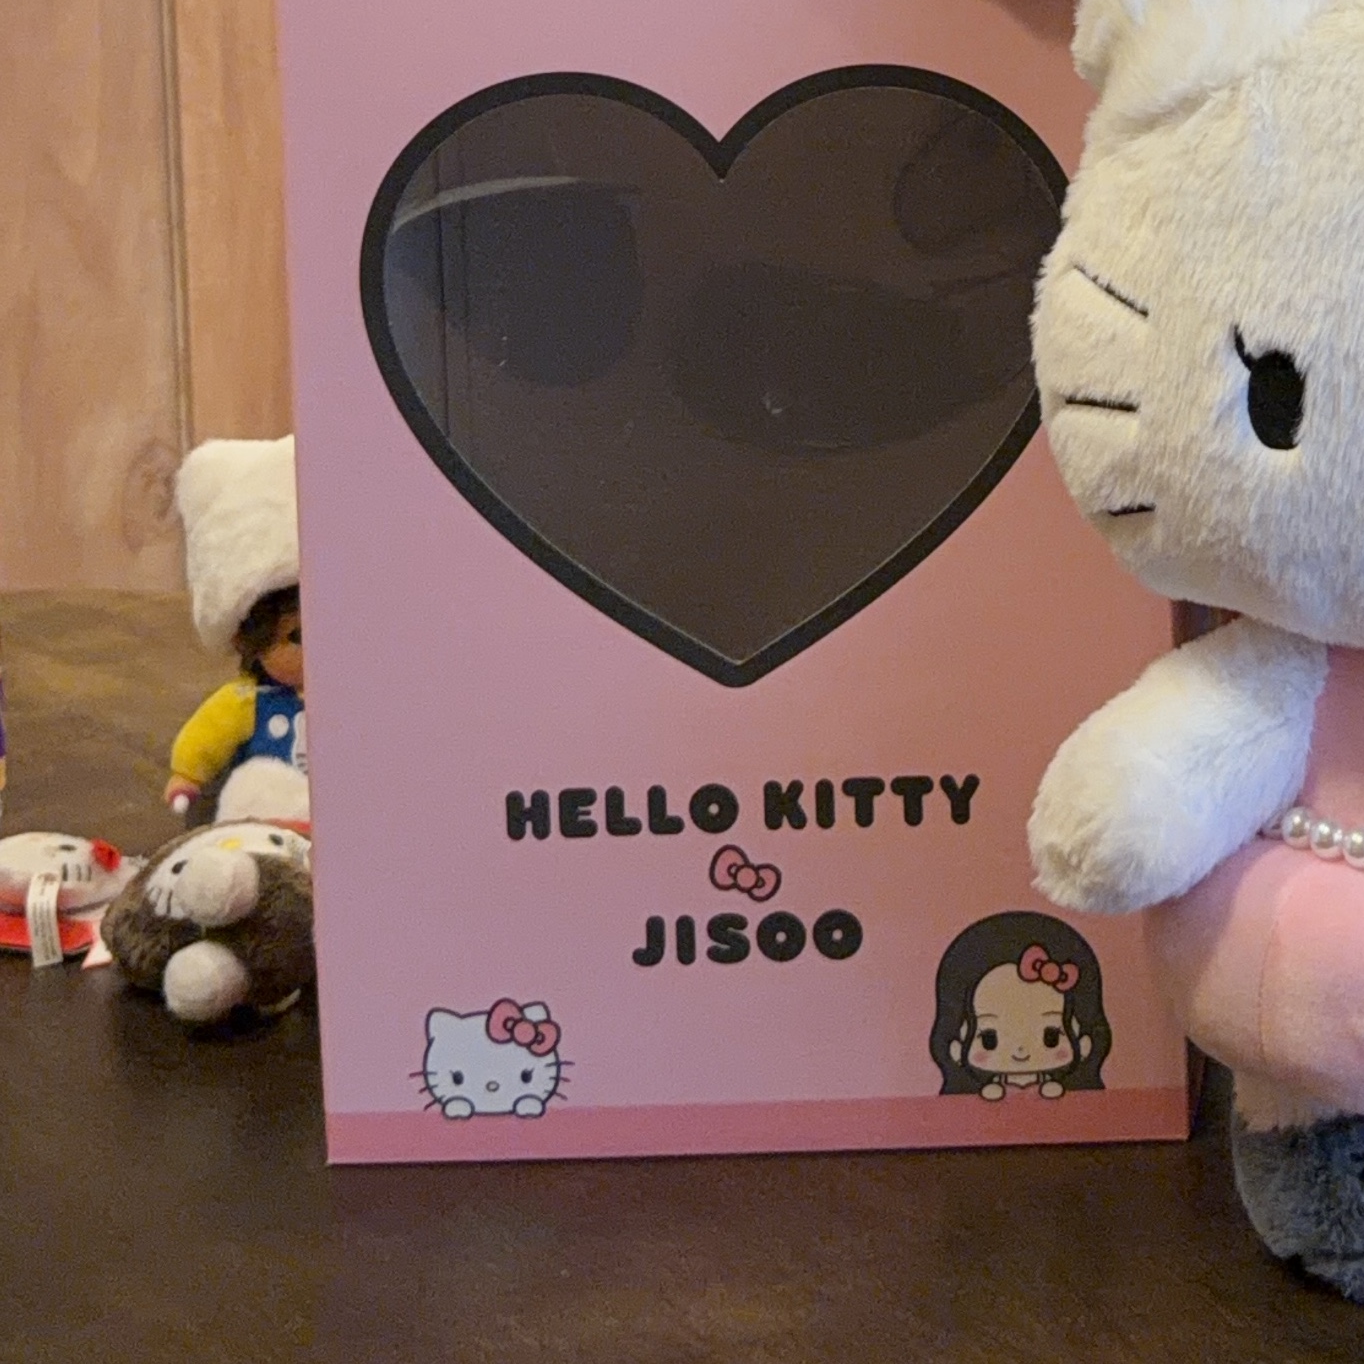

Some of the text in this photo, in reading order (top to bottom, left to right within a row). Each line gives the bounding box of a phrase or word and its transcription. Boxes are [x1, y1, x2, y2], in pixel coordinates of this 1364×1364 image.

[505, 773, 981, 841] HELLO KITTY
[631, 908, 864, 967] JISOO
